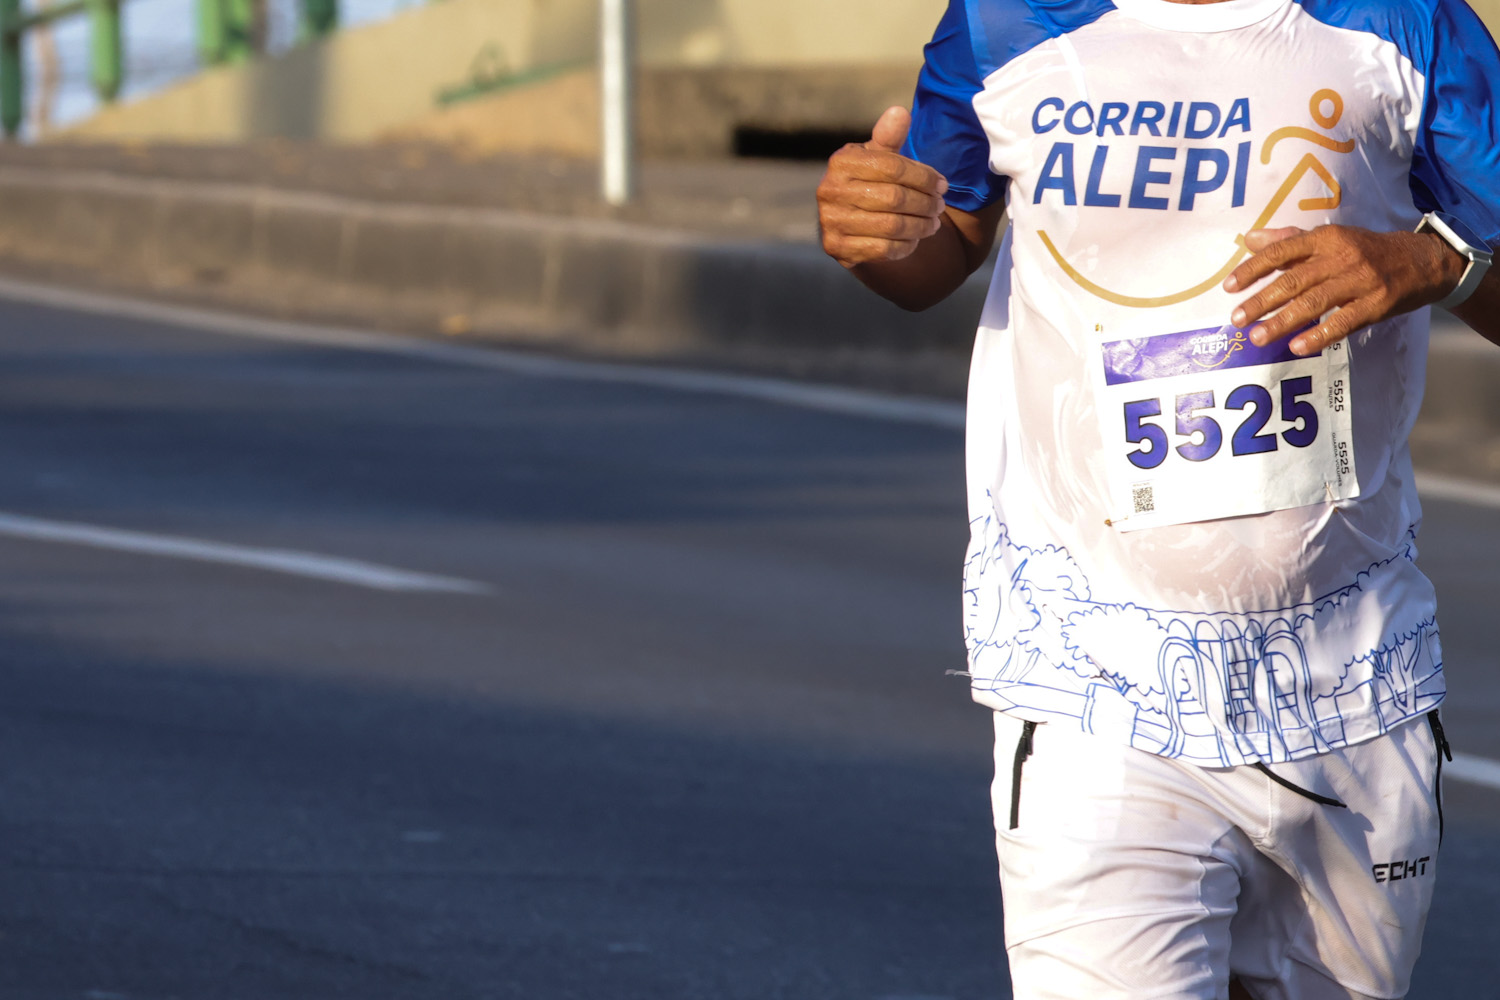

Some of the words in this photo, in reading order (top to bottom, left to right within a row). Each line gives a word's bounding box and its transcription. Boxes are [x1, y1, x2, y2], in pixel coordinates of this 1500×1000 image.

[1032, 97, 1251, 139] CORRIDA
[1033, 141, 1251, 211] ALEPI
[1191, 340, 1228, 356] ALEPI
[1334, 380, 1344, 412] 5525
[1123, 375, 1319, 470] 5525
[1338, 442, 1350, 474] 5525
[1372, 856, 1430, 883] ECHT
